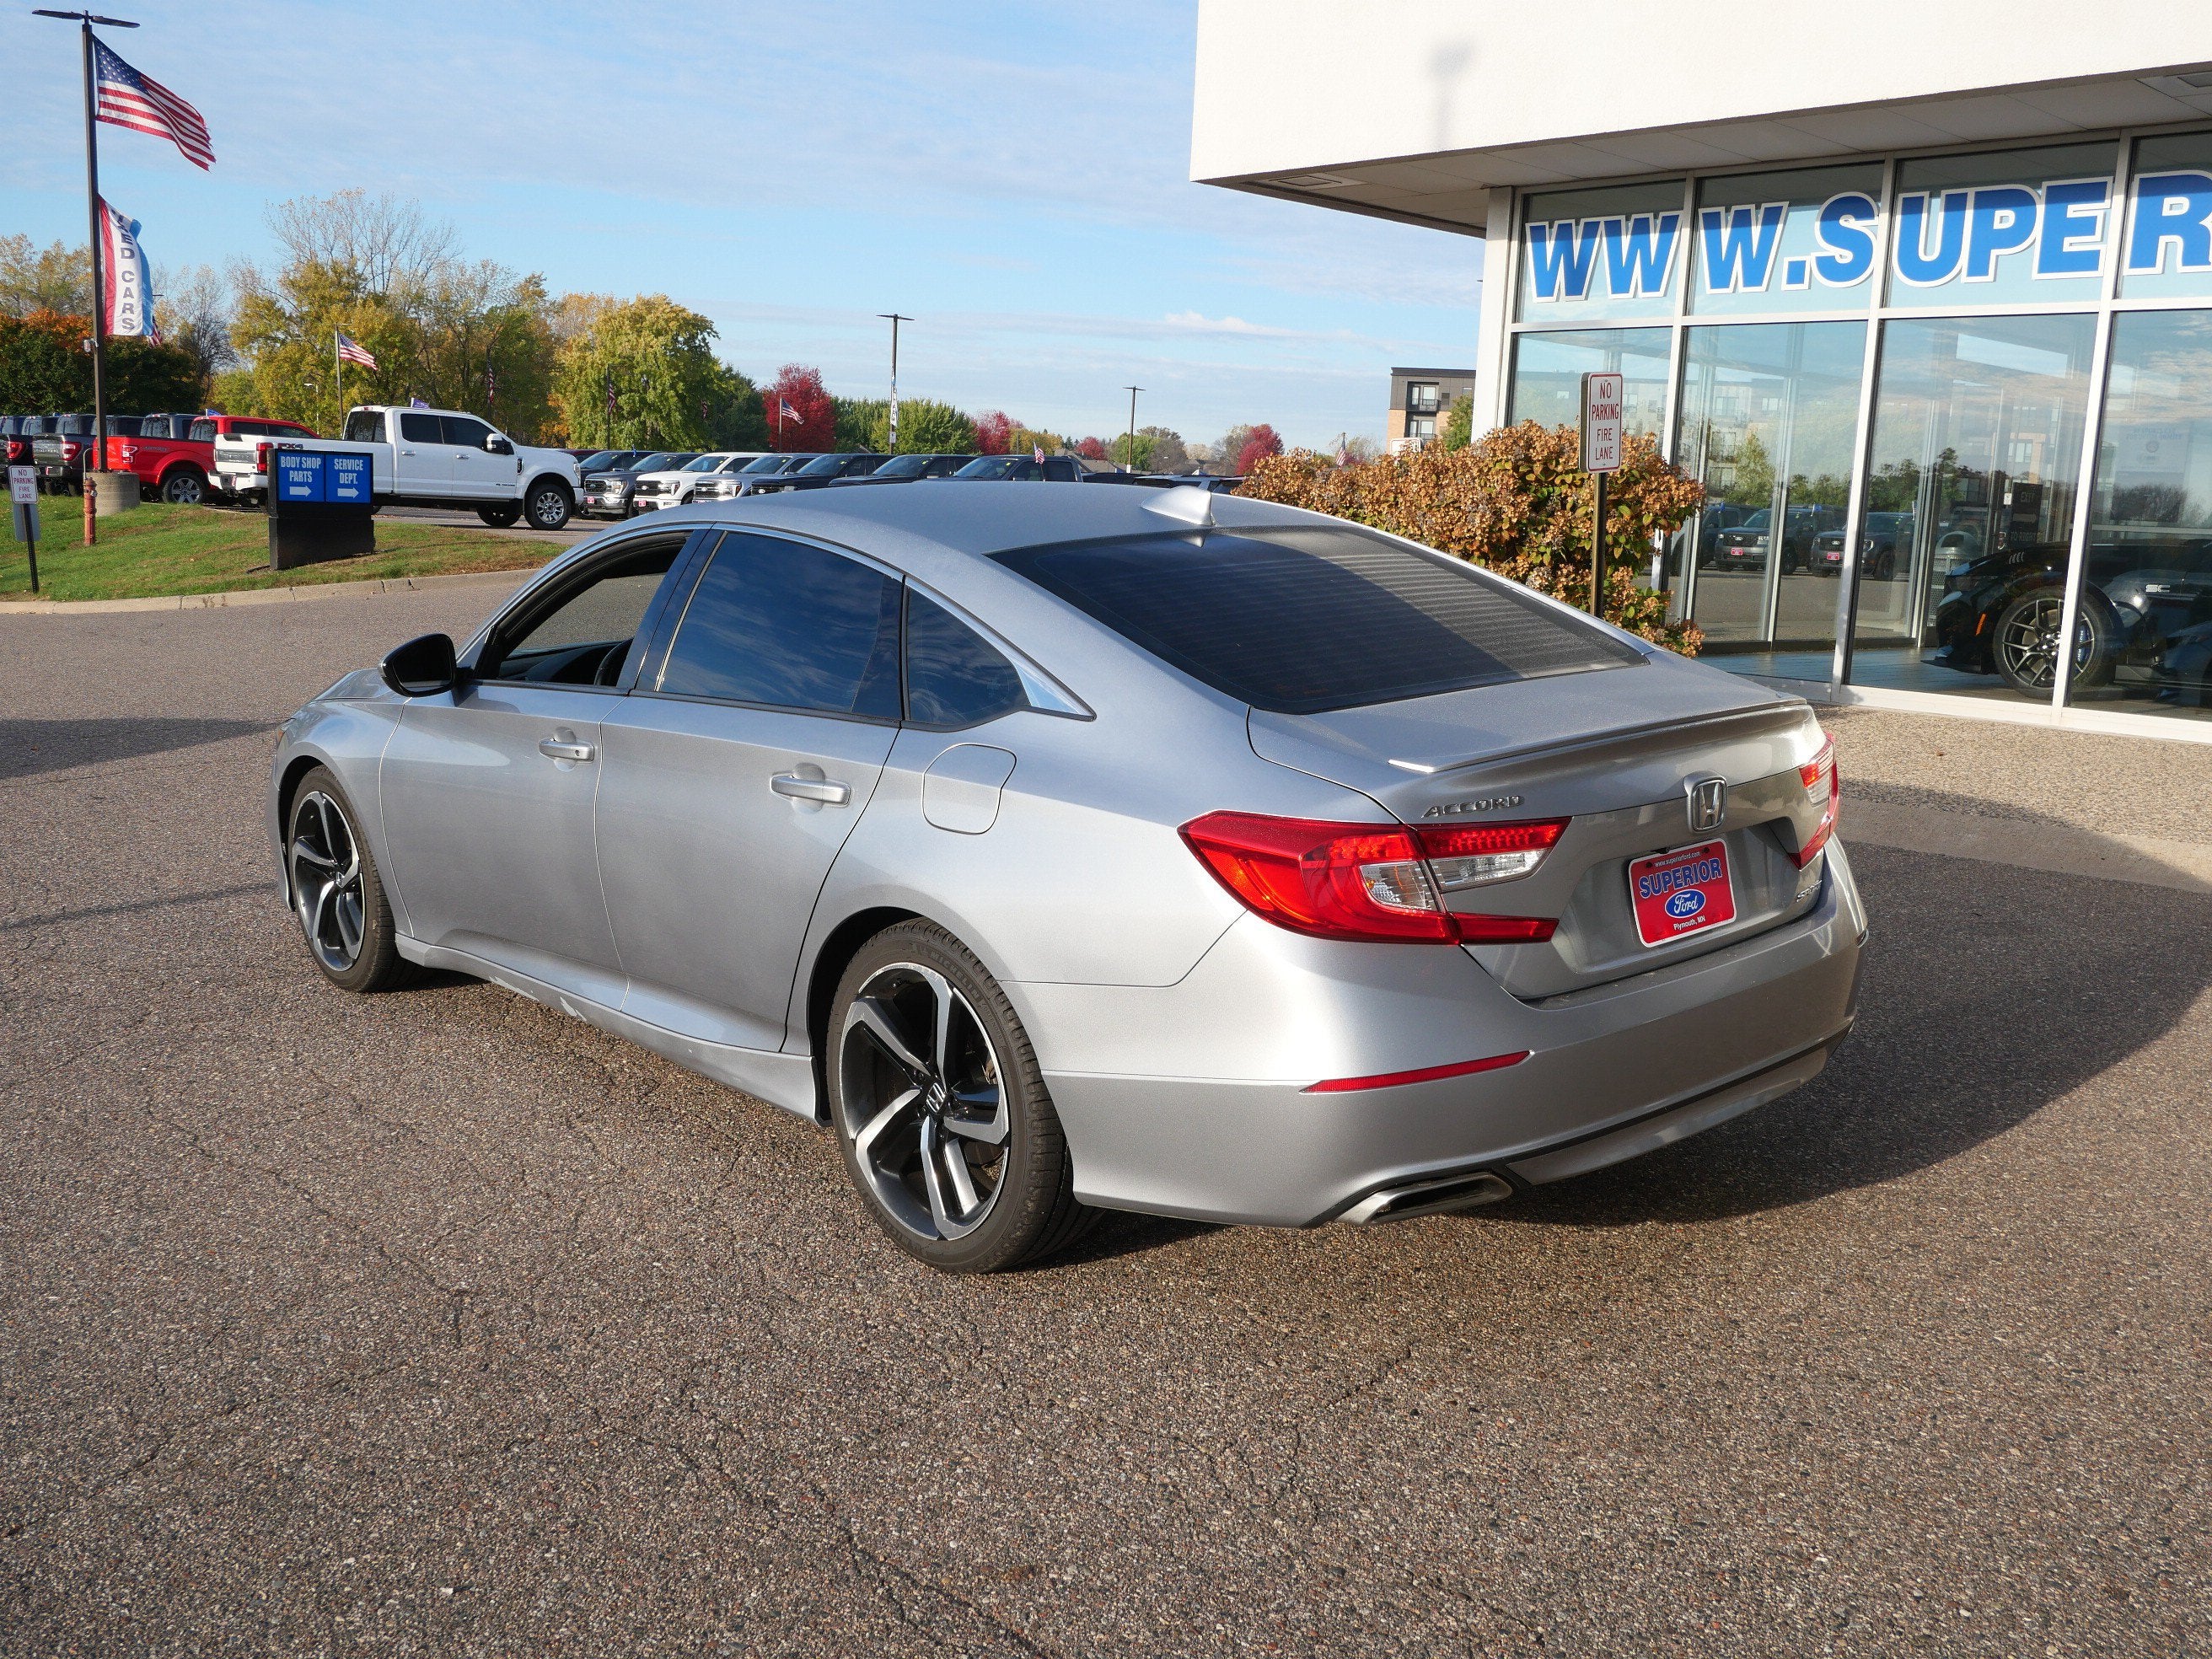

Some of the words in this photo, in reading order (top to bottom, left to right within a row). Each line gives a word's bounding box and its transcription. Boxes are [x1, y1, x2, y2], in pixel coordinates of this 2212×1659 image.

[121, 270, 136, 330] CARS
[1599, 382, 1612, 400] NO
[1592, 404, 1619, 421] PARKING
[1597, 427, 1613, 442] FIRE
[1595, 446, 1613, 461] LANE
[281, 456, 300, 468] BODY
[302, 457, 321, 470] SHOP
[334, 458, 364, 471] SERVICE
[289, 470, 313, 483] PARTS
[339, 472, 358, 485] DEPT.
[1420, 795, 1526, 819] ACCORD
[1655, 851, 1701, 867] www.superiorford.com
[1639, 858, 1722, 899] SUPERIOR
[1673, 893, 1699, 915] Ford
[1673, 918, 1698, 931] Plymouth,
[1697, 915, 1706, 924] MN
